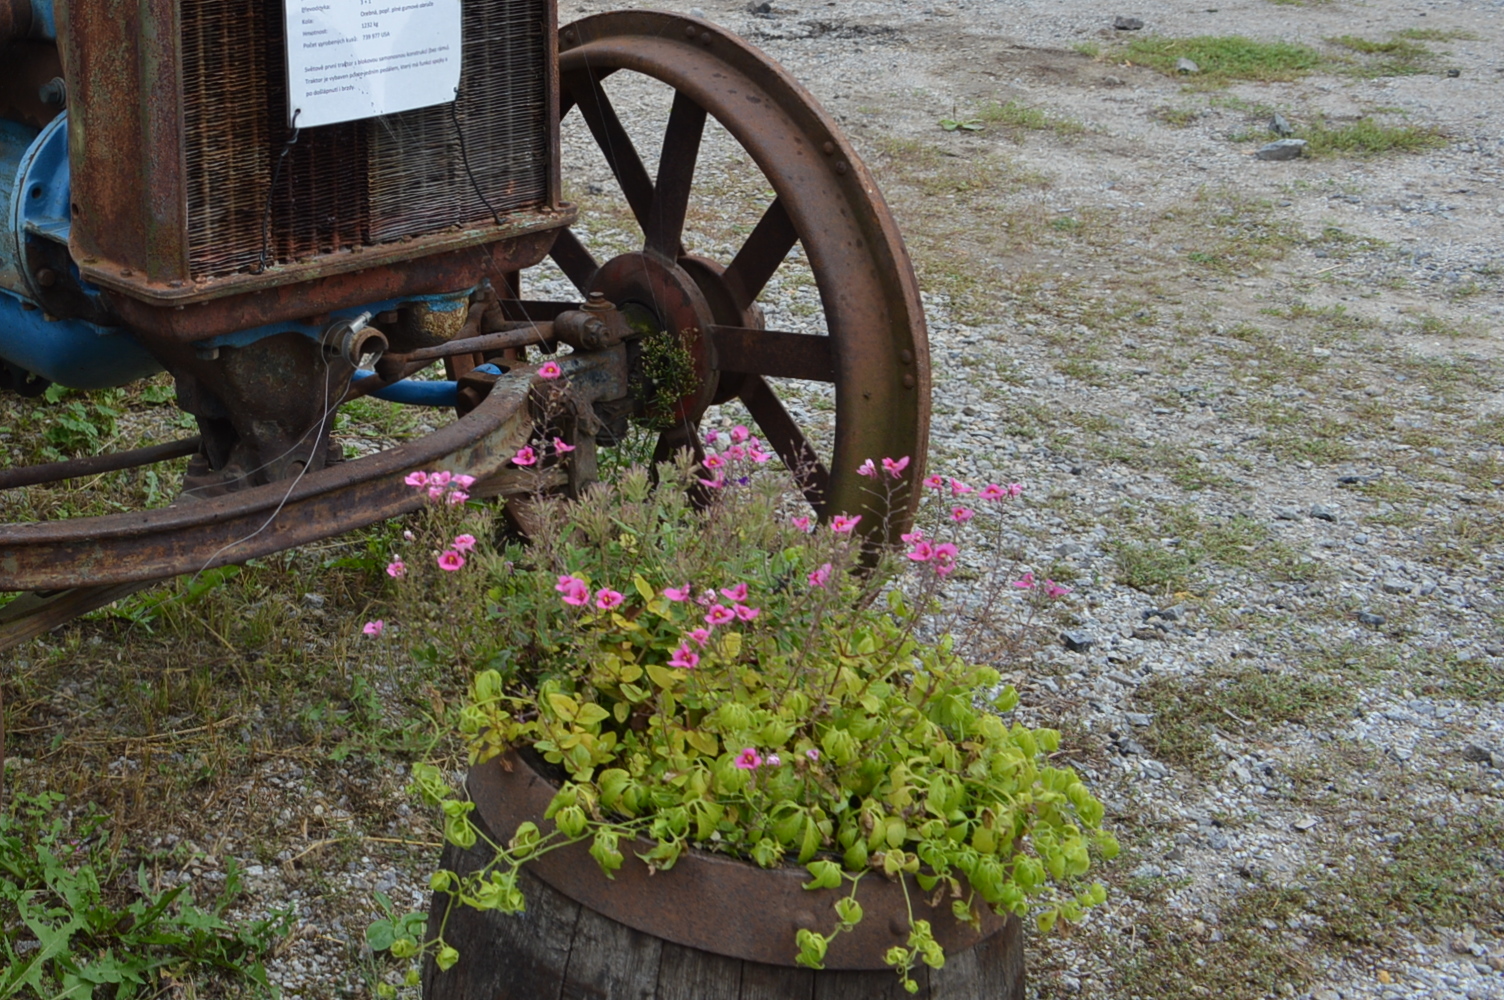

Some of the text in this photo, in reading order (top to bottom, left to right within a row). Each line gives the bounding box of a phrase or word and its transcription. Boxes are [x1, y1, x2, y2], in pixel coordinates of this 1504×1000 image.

[302, 28, 328, 36] Hmotnost:
[380, 30, 391, 38] USA
[317, 37, 345, 47] vyrobených
[324, 63, 337, 71] první
[337, 60, 353, 68] traktor
[305, 77, 323, 85] Traktor
[329, 74, 349, 82] vybaven
